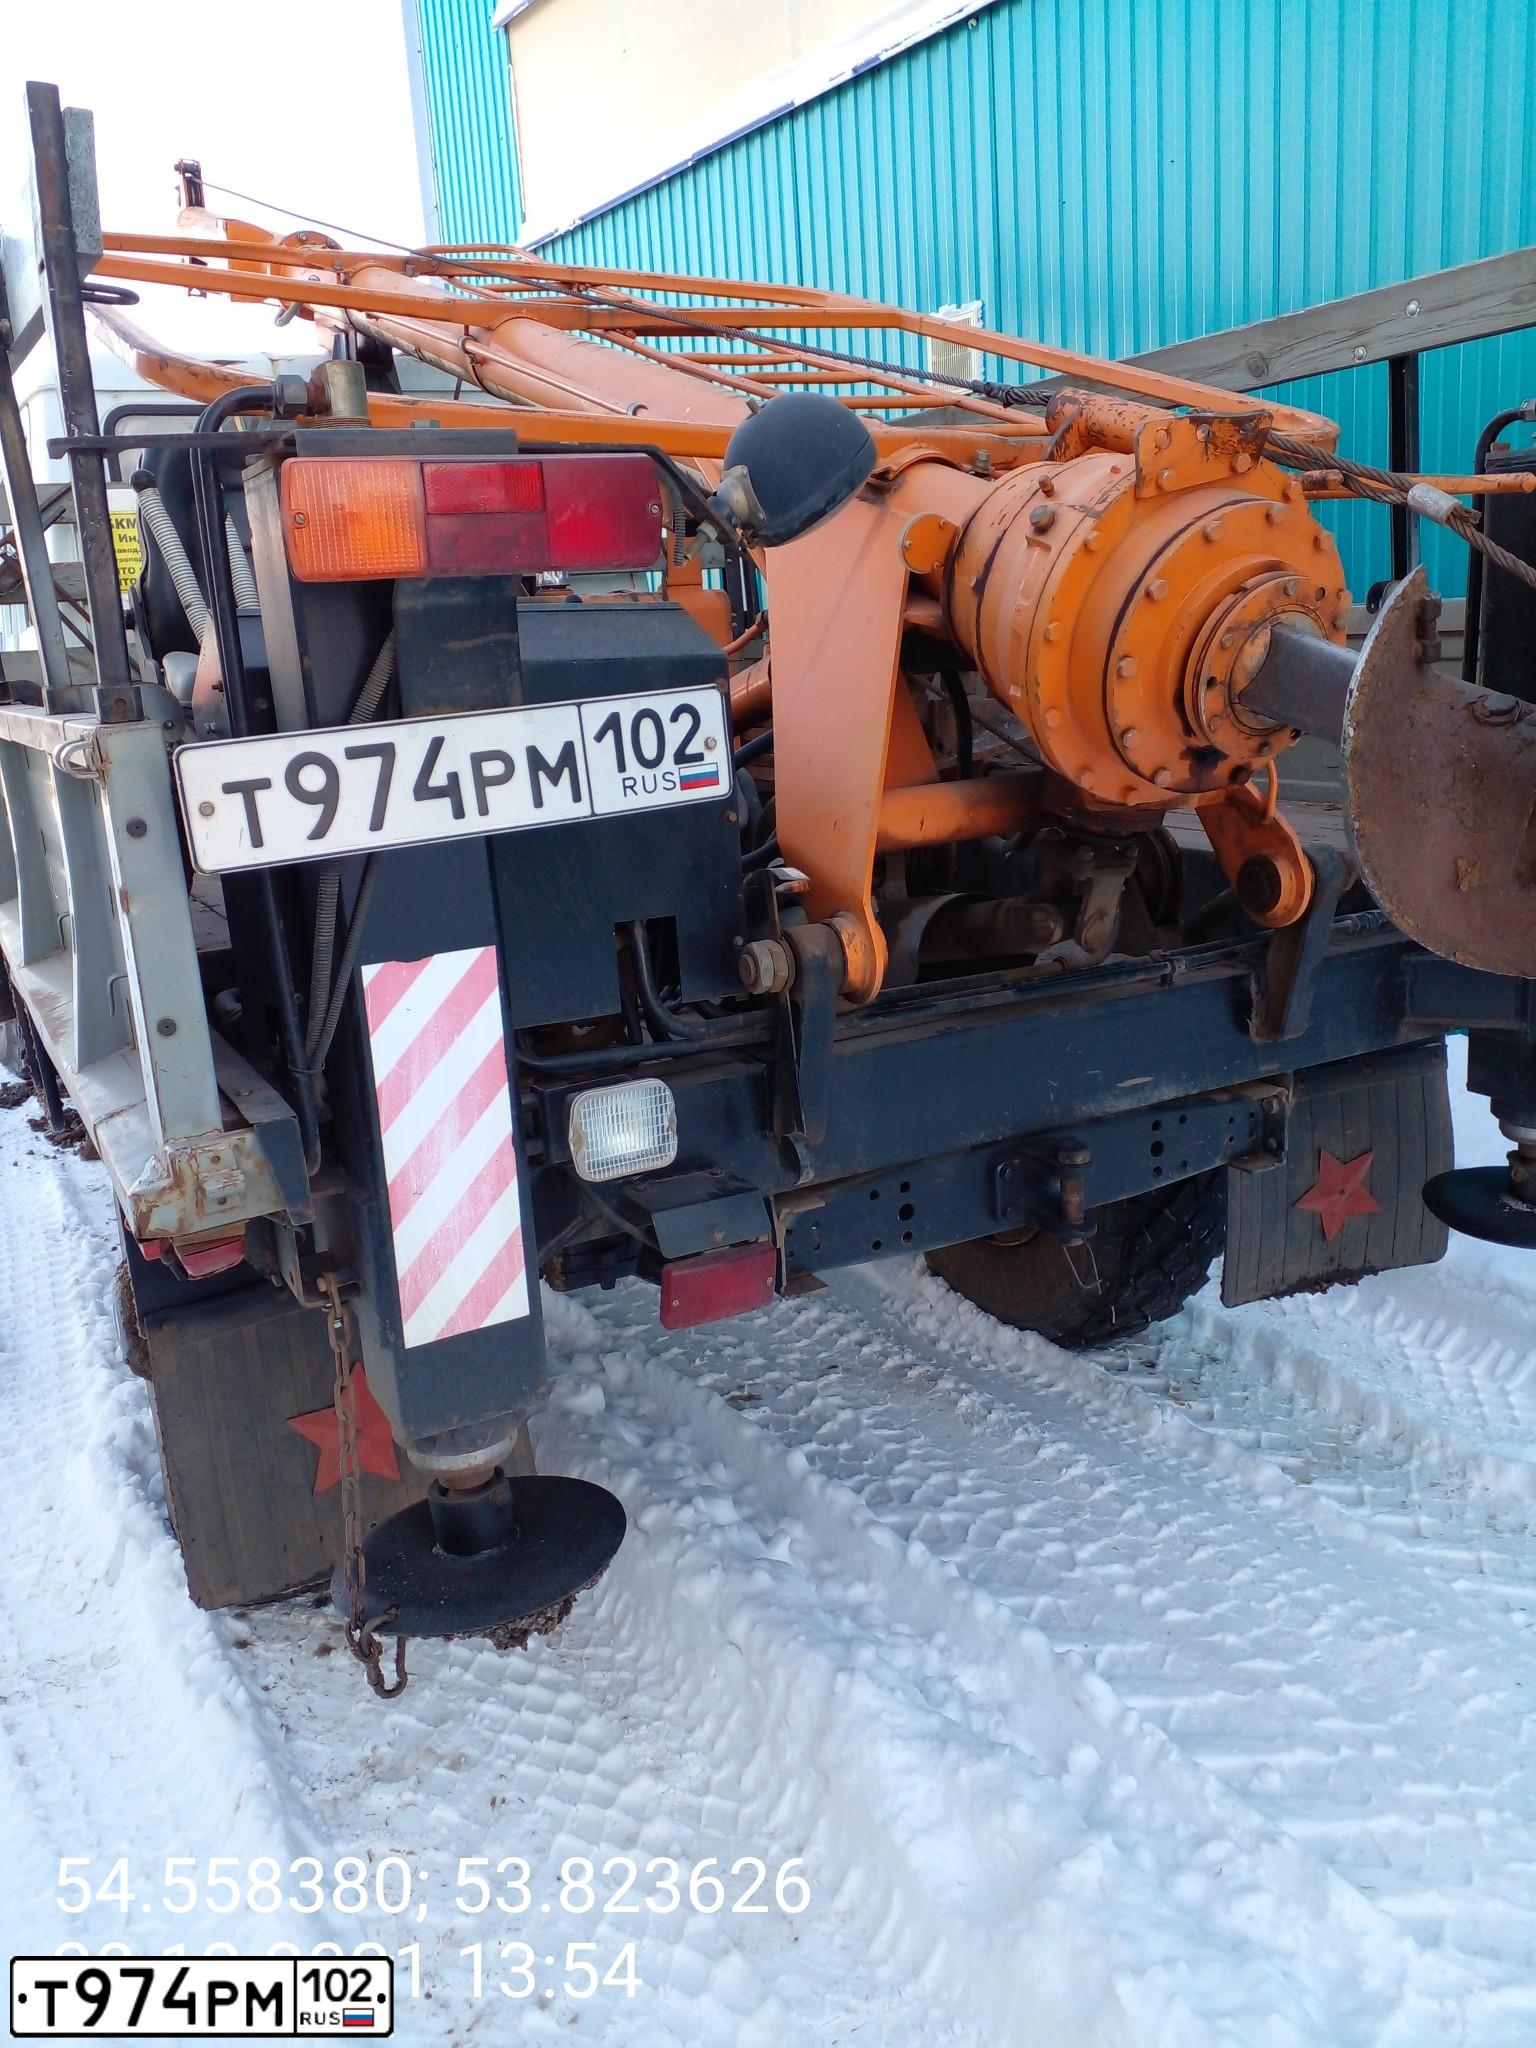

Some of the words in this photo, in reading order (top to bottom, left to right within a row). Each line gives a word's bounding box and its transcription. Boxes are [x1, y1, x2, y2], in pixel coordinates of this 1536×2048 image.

[118, 533, 140, 544] Ин
[118, 567, 136, 575] ТО
[119, 578, 137, 586] ТО
[221, 735, 583, 849] Т974РМ
[592, 703, 705, 774] 102
[621, 771, 677, 798] RUS
